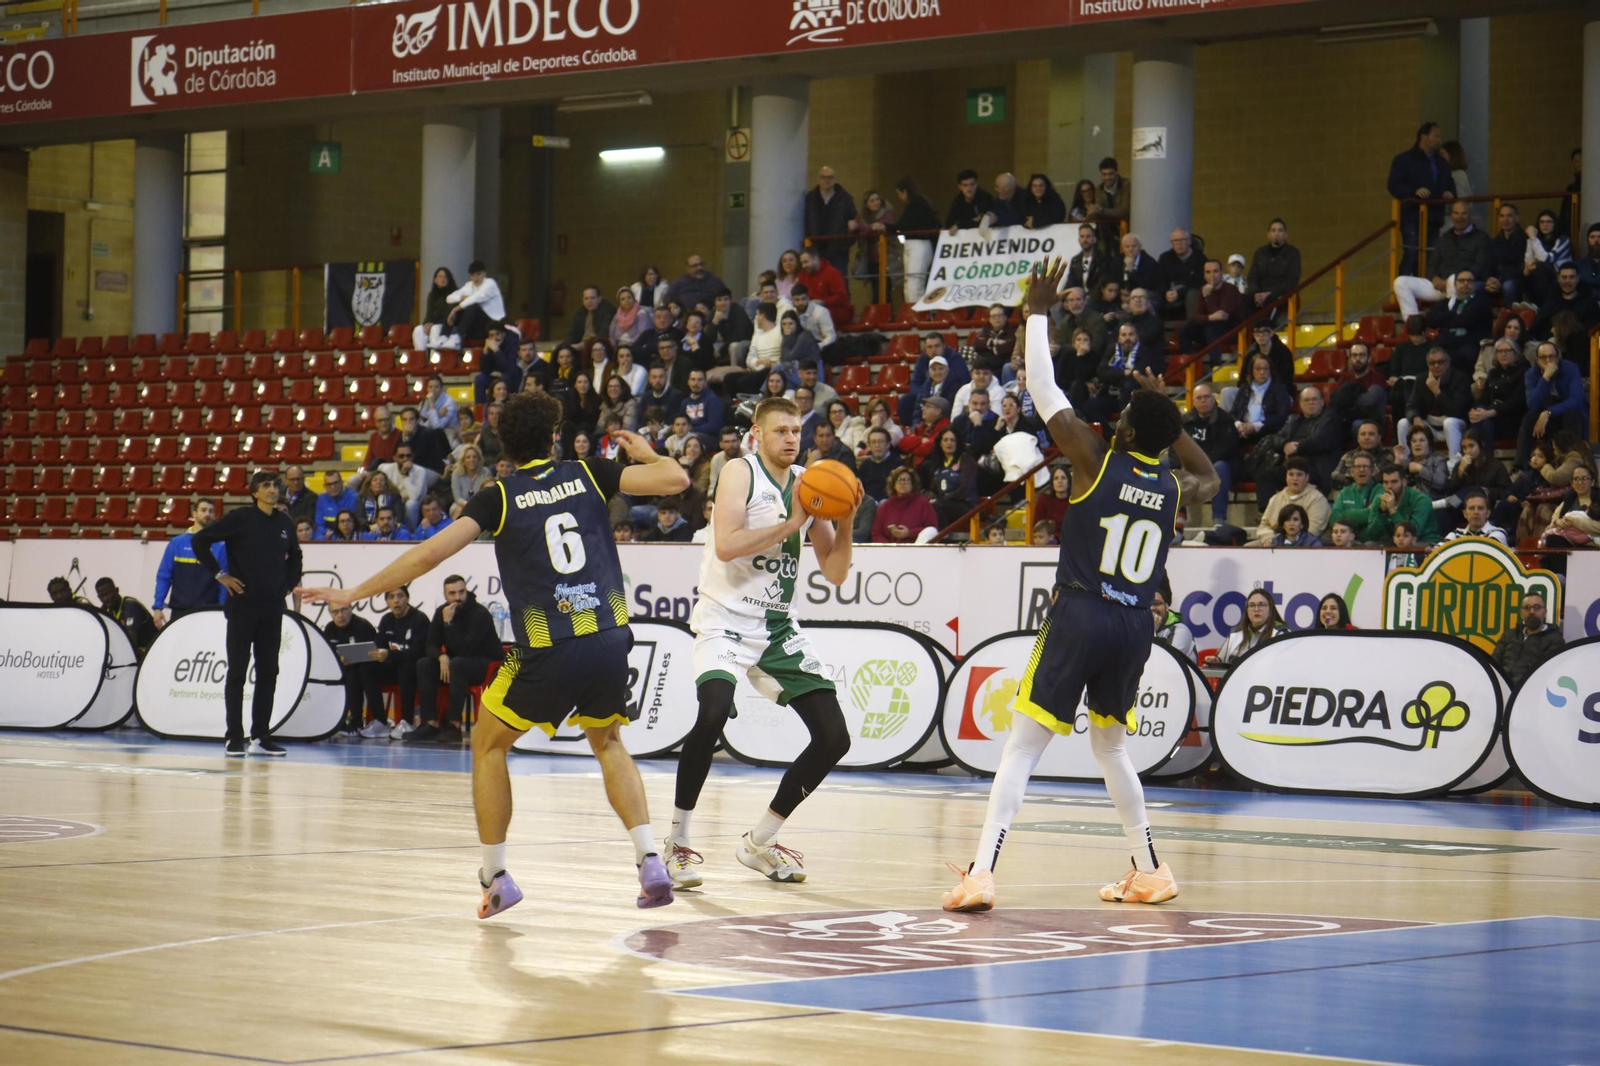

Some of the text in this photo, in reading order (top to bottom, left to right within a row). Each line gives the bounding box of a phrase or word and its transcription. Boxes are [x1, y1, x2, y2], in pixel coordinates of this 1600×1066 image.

[846, 0, 865, 25] DE
[1080, 0, 1143, 16] Instituto
[446, 0, 640, 51] IMDECO
[185, 40, 276, 72] Diputación
[392, 47, 637, 84] Instituto Municipal de Deportes Córdoba
[184, 67, 277, 94] de Córdoba
[15, 98, 53, 112] Córdoba
[977, 94, 994, 118] B
[317, 147, 331, 168] A
[938, 237, 1056, 259] BIENVENIDO
[933, 266, 947, 281] A
[514, 477, 587, 510] CORRALIZA
[1118, 483, 1166, 511] IKPEZE
[544, 511, 587, 575] 6
[1099, 512, 1163, 584] 10
[752, 553, 798, 579] coto
[36, 670, 60, 679] HOTELS
[168, 688, 199, 699] Partners
[646, 652, 672, 731] rg3print.es
[724, 917, 1342, 971] IMDECO
